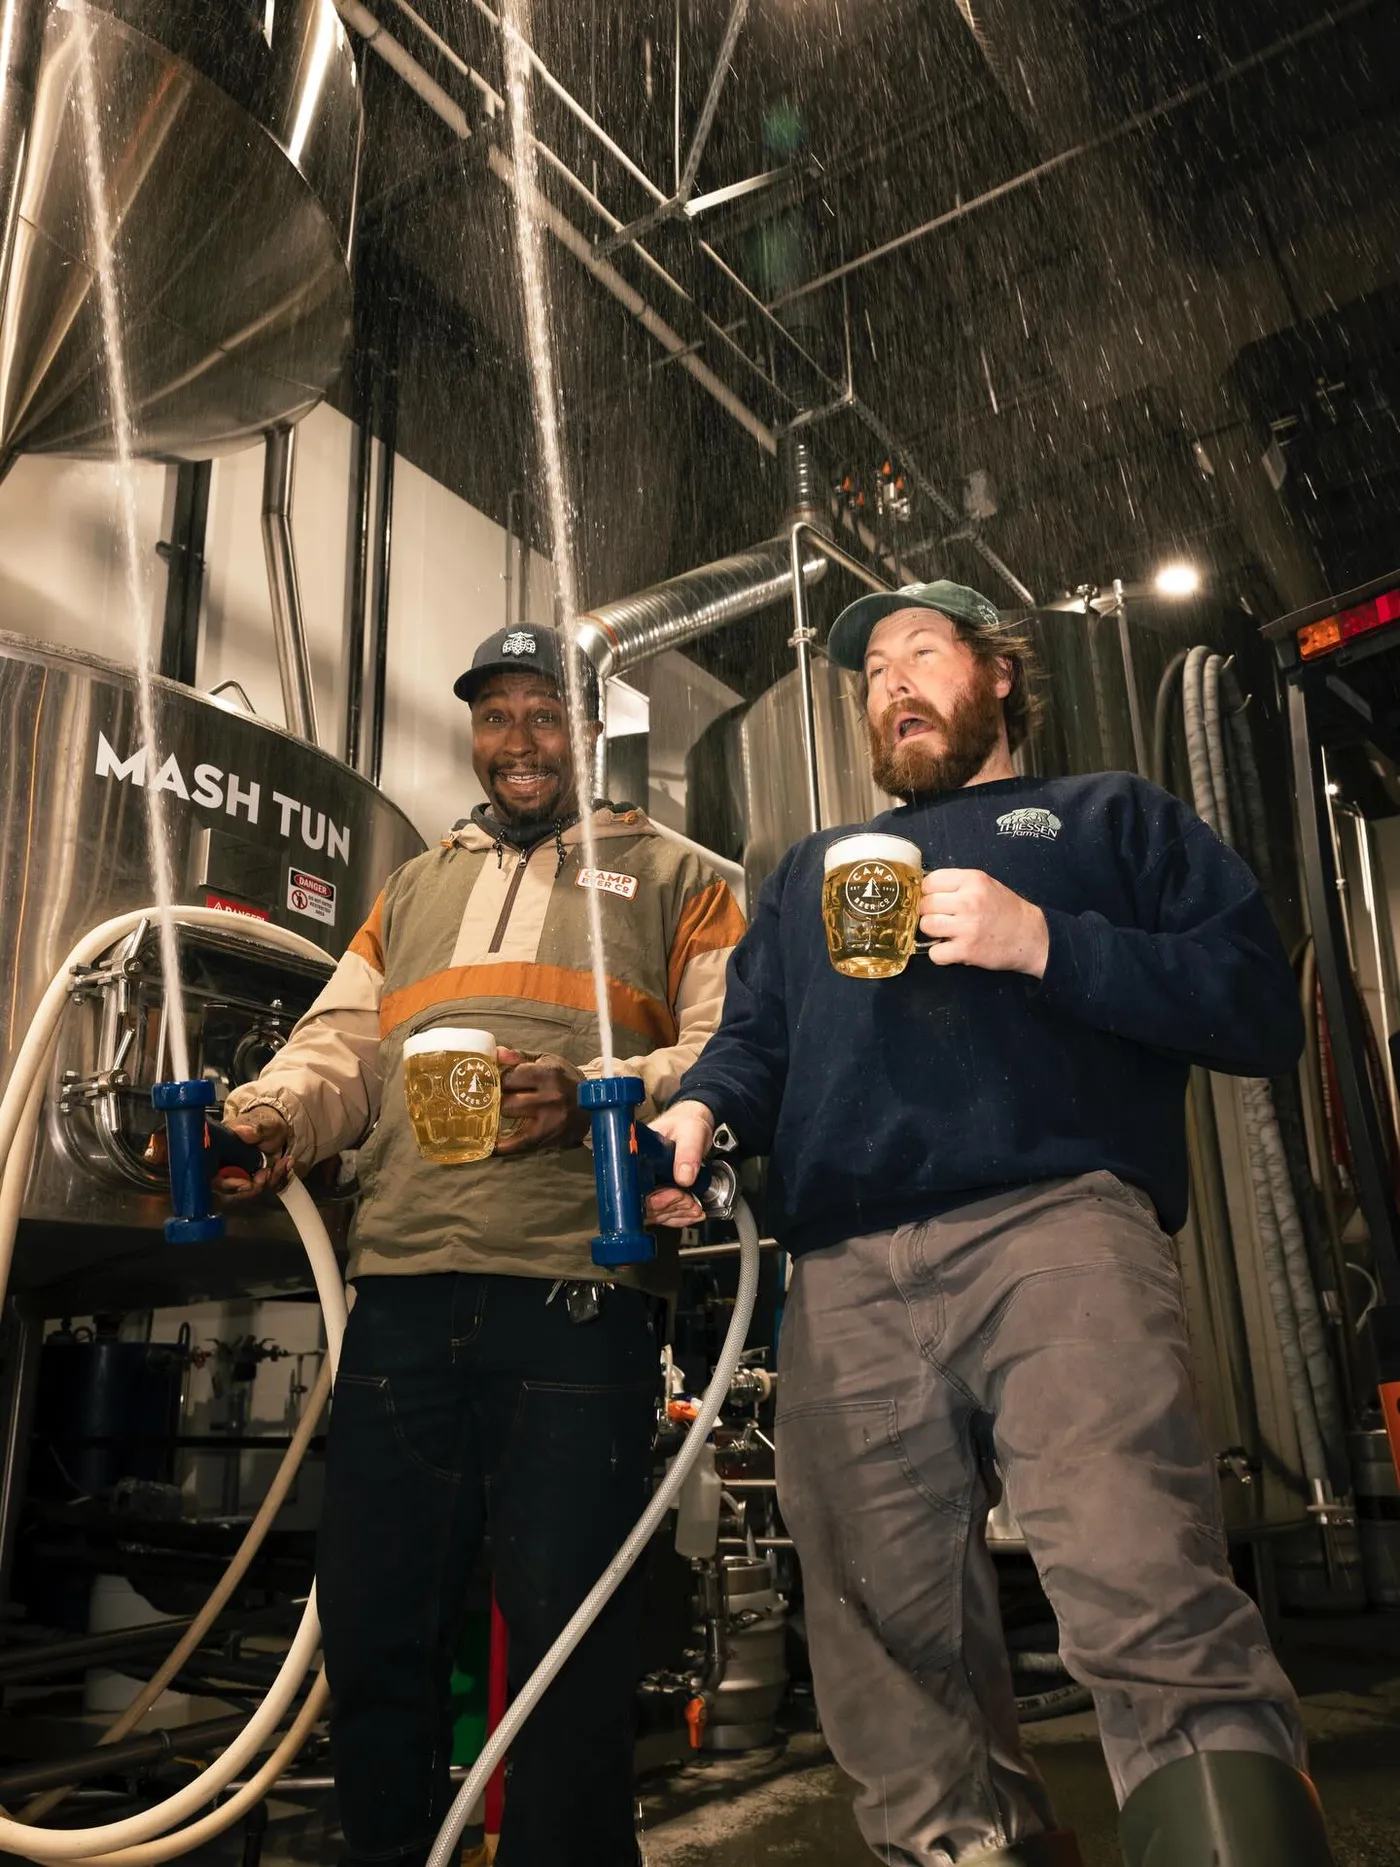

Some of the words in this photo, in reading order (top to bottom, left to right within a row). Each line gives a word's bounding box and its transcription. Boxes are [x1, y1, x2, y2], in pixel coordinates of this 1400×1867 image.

[95, 730, 261, 825] MASH
[272, 790, 351, 867] TUN
[1000, 823, 1058, 838] THIESSEN
[852, 866, 893, 882] CAMP
[299, 877, 328, 896] DANGER
[581, 877, 612, 889] BER
[853, 896, 876, 911] BEER
[456, 1061, 491, 1078] CAMP
[460, 1091, 481, 1106] BEER
